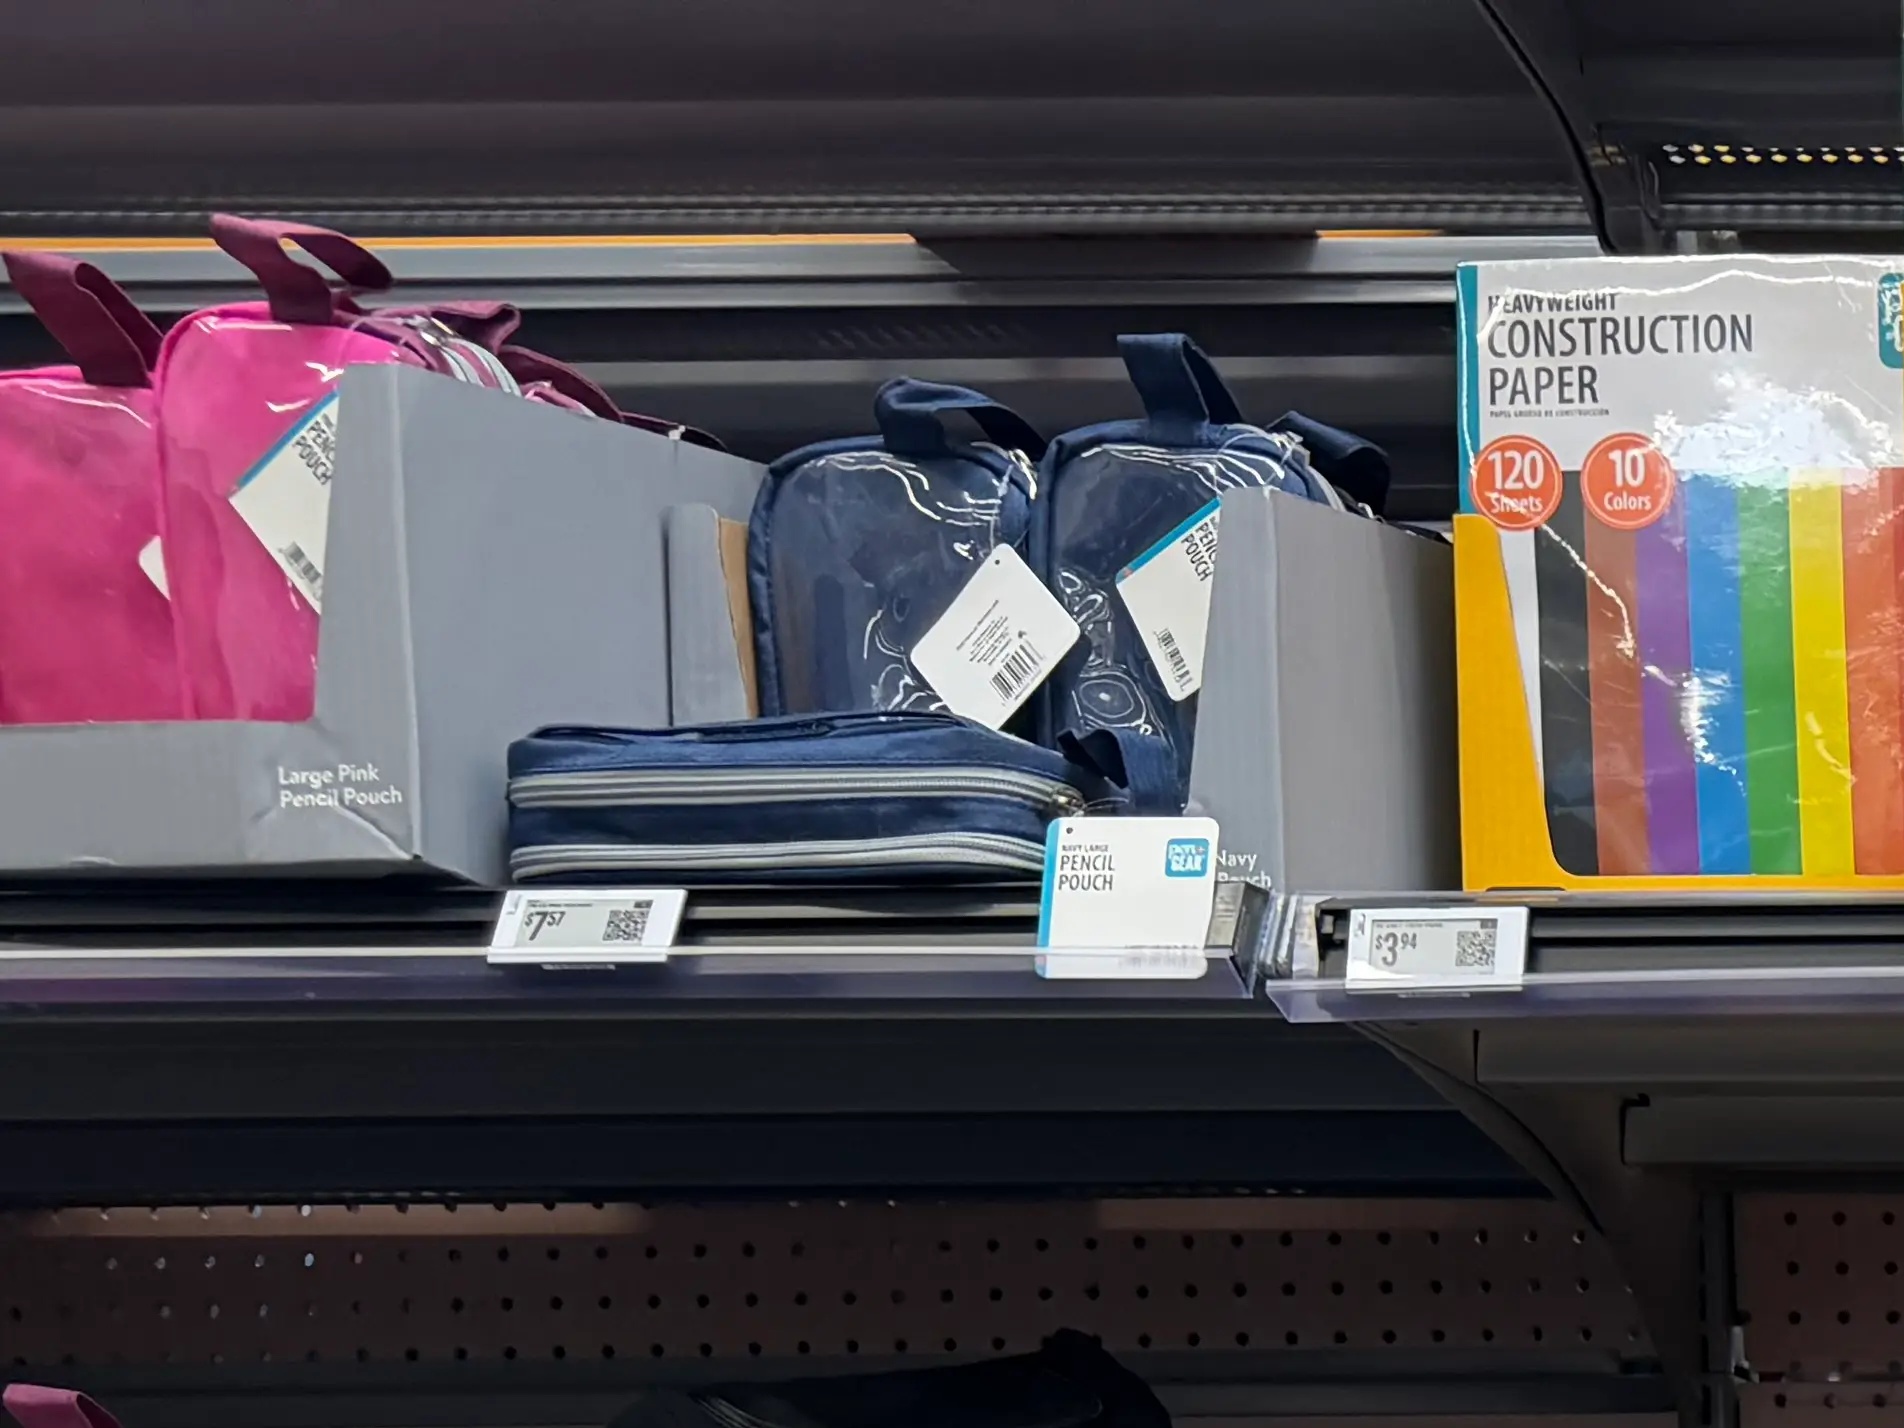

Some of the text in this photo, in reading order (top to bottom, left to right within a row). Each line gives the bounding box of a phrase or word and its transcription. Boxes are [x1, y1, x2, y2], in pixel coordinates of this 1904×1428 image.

[1488, 293, 1617, 312] HEAVYWEIGHT
[1489, 367, 1598, 405] PAPER
[1488, 450, 1544, 488] 120
[1603, 492, 1652, 511] Colors
[278, 763, 380, 788] Large Pink
[279, 785, 402, 809] Pencil Pouch
[1060, 853, 1116, 872] PENCIL
[1059, 872, 1114, 891] POUCH
